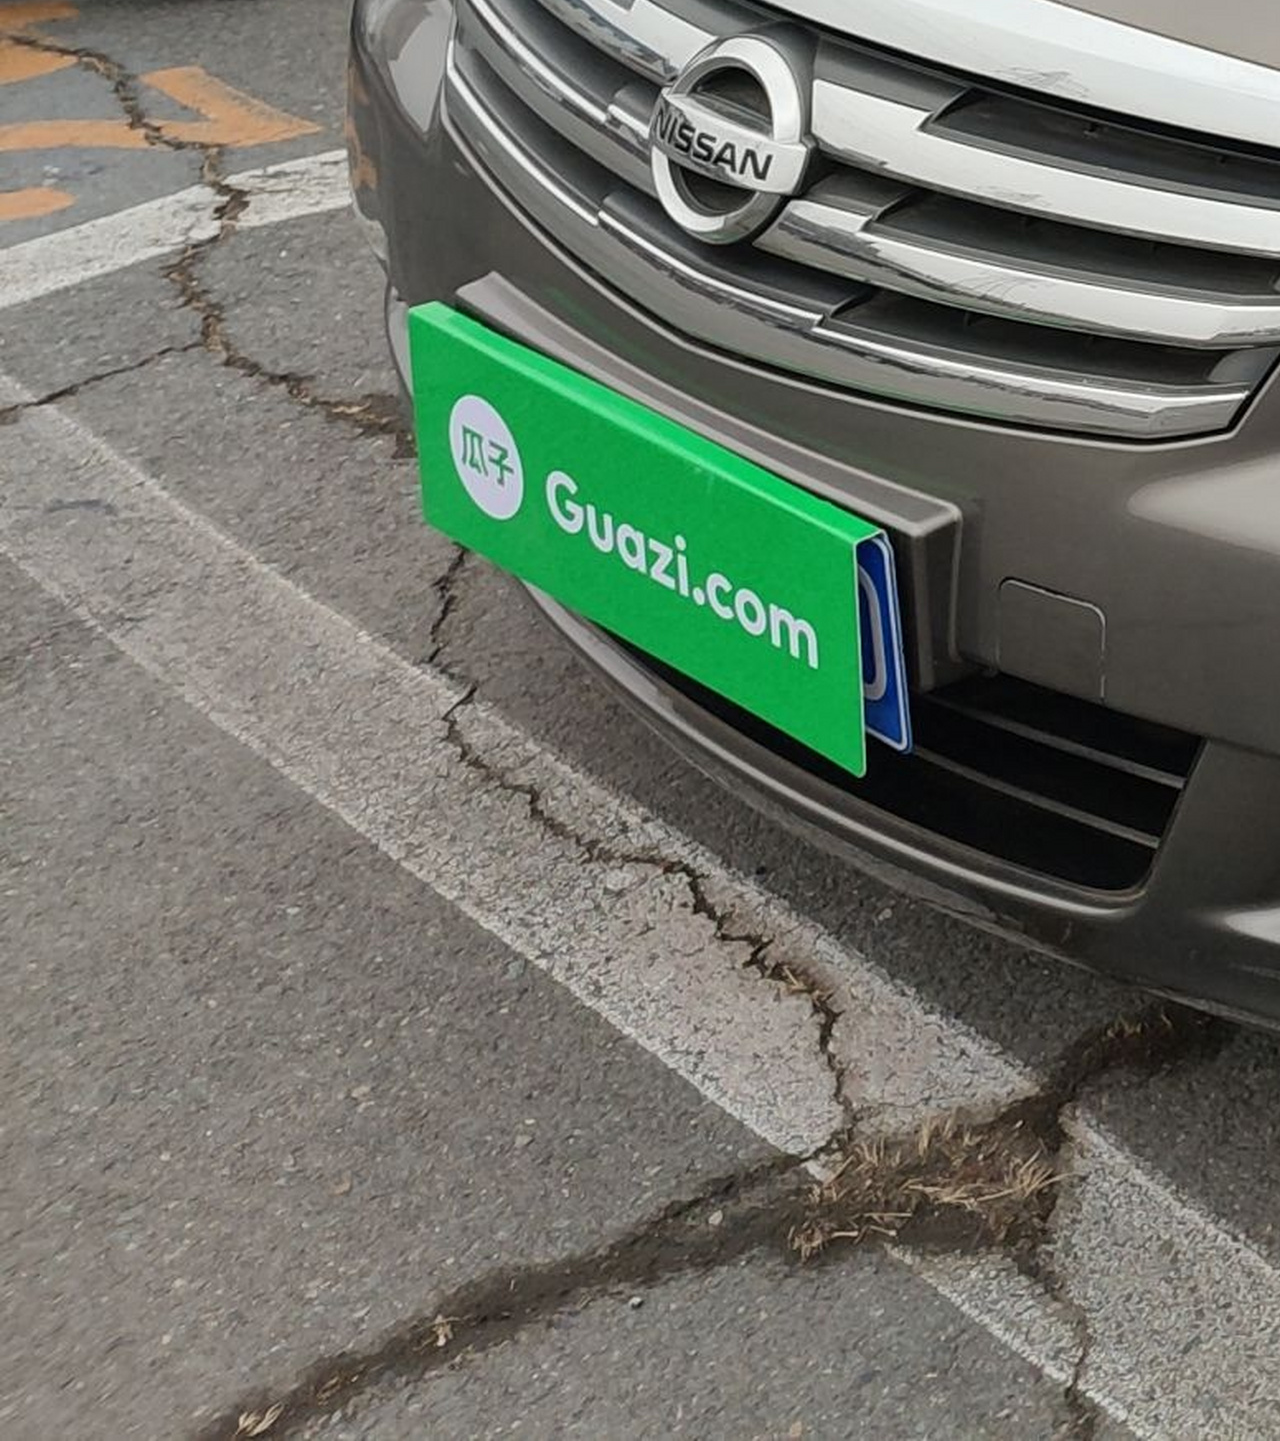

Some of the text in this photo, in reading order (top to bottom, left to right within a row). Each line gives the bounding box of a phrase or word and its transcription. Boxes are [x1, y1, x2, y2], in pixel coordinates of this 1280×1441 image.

[655, 107, 773, 181] NISSAN
[461, 424, 515, 486] 瓜子
[546, 470, 819, 670] Guazi.com
